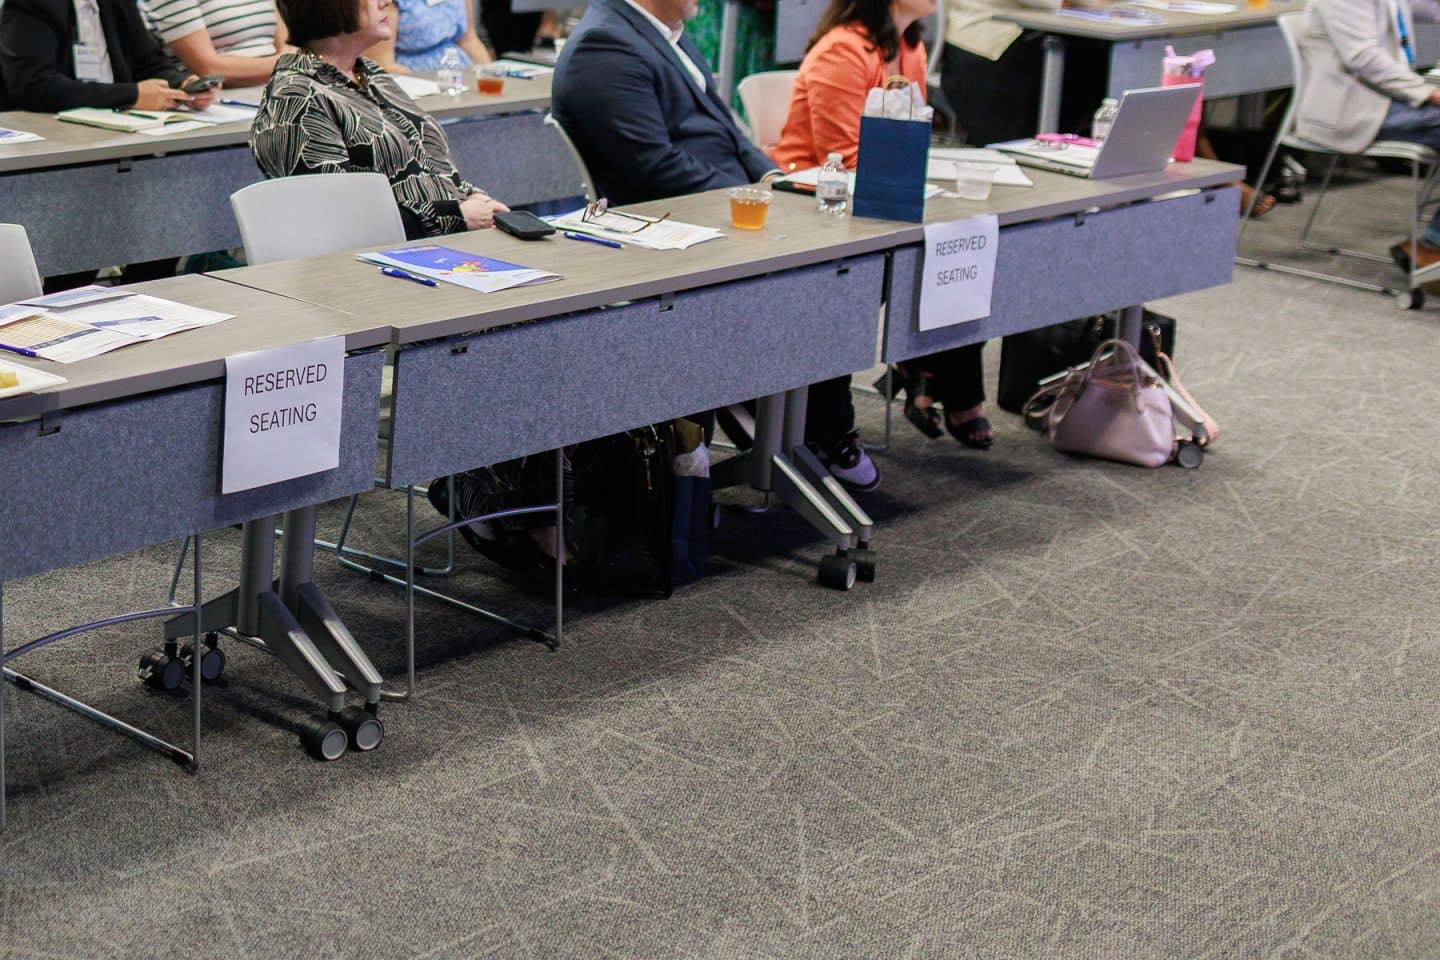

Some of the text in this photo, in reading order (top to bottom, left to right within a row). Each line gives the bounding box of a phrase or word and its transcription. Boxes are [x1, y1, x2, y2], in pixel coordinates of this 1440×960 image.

[935, 235, 987, 257] RESERVED
[936, 265, 978, 287] SEATING
[244, 363, 328, 397] RESERVED
[249, 403, 317, 434] SEATING
